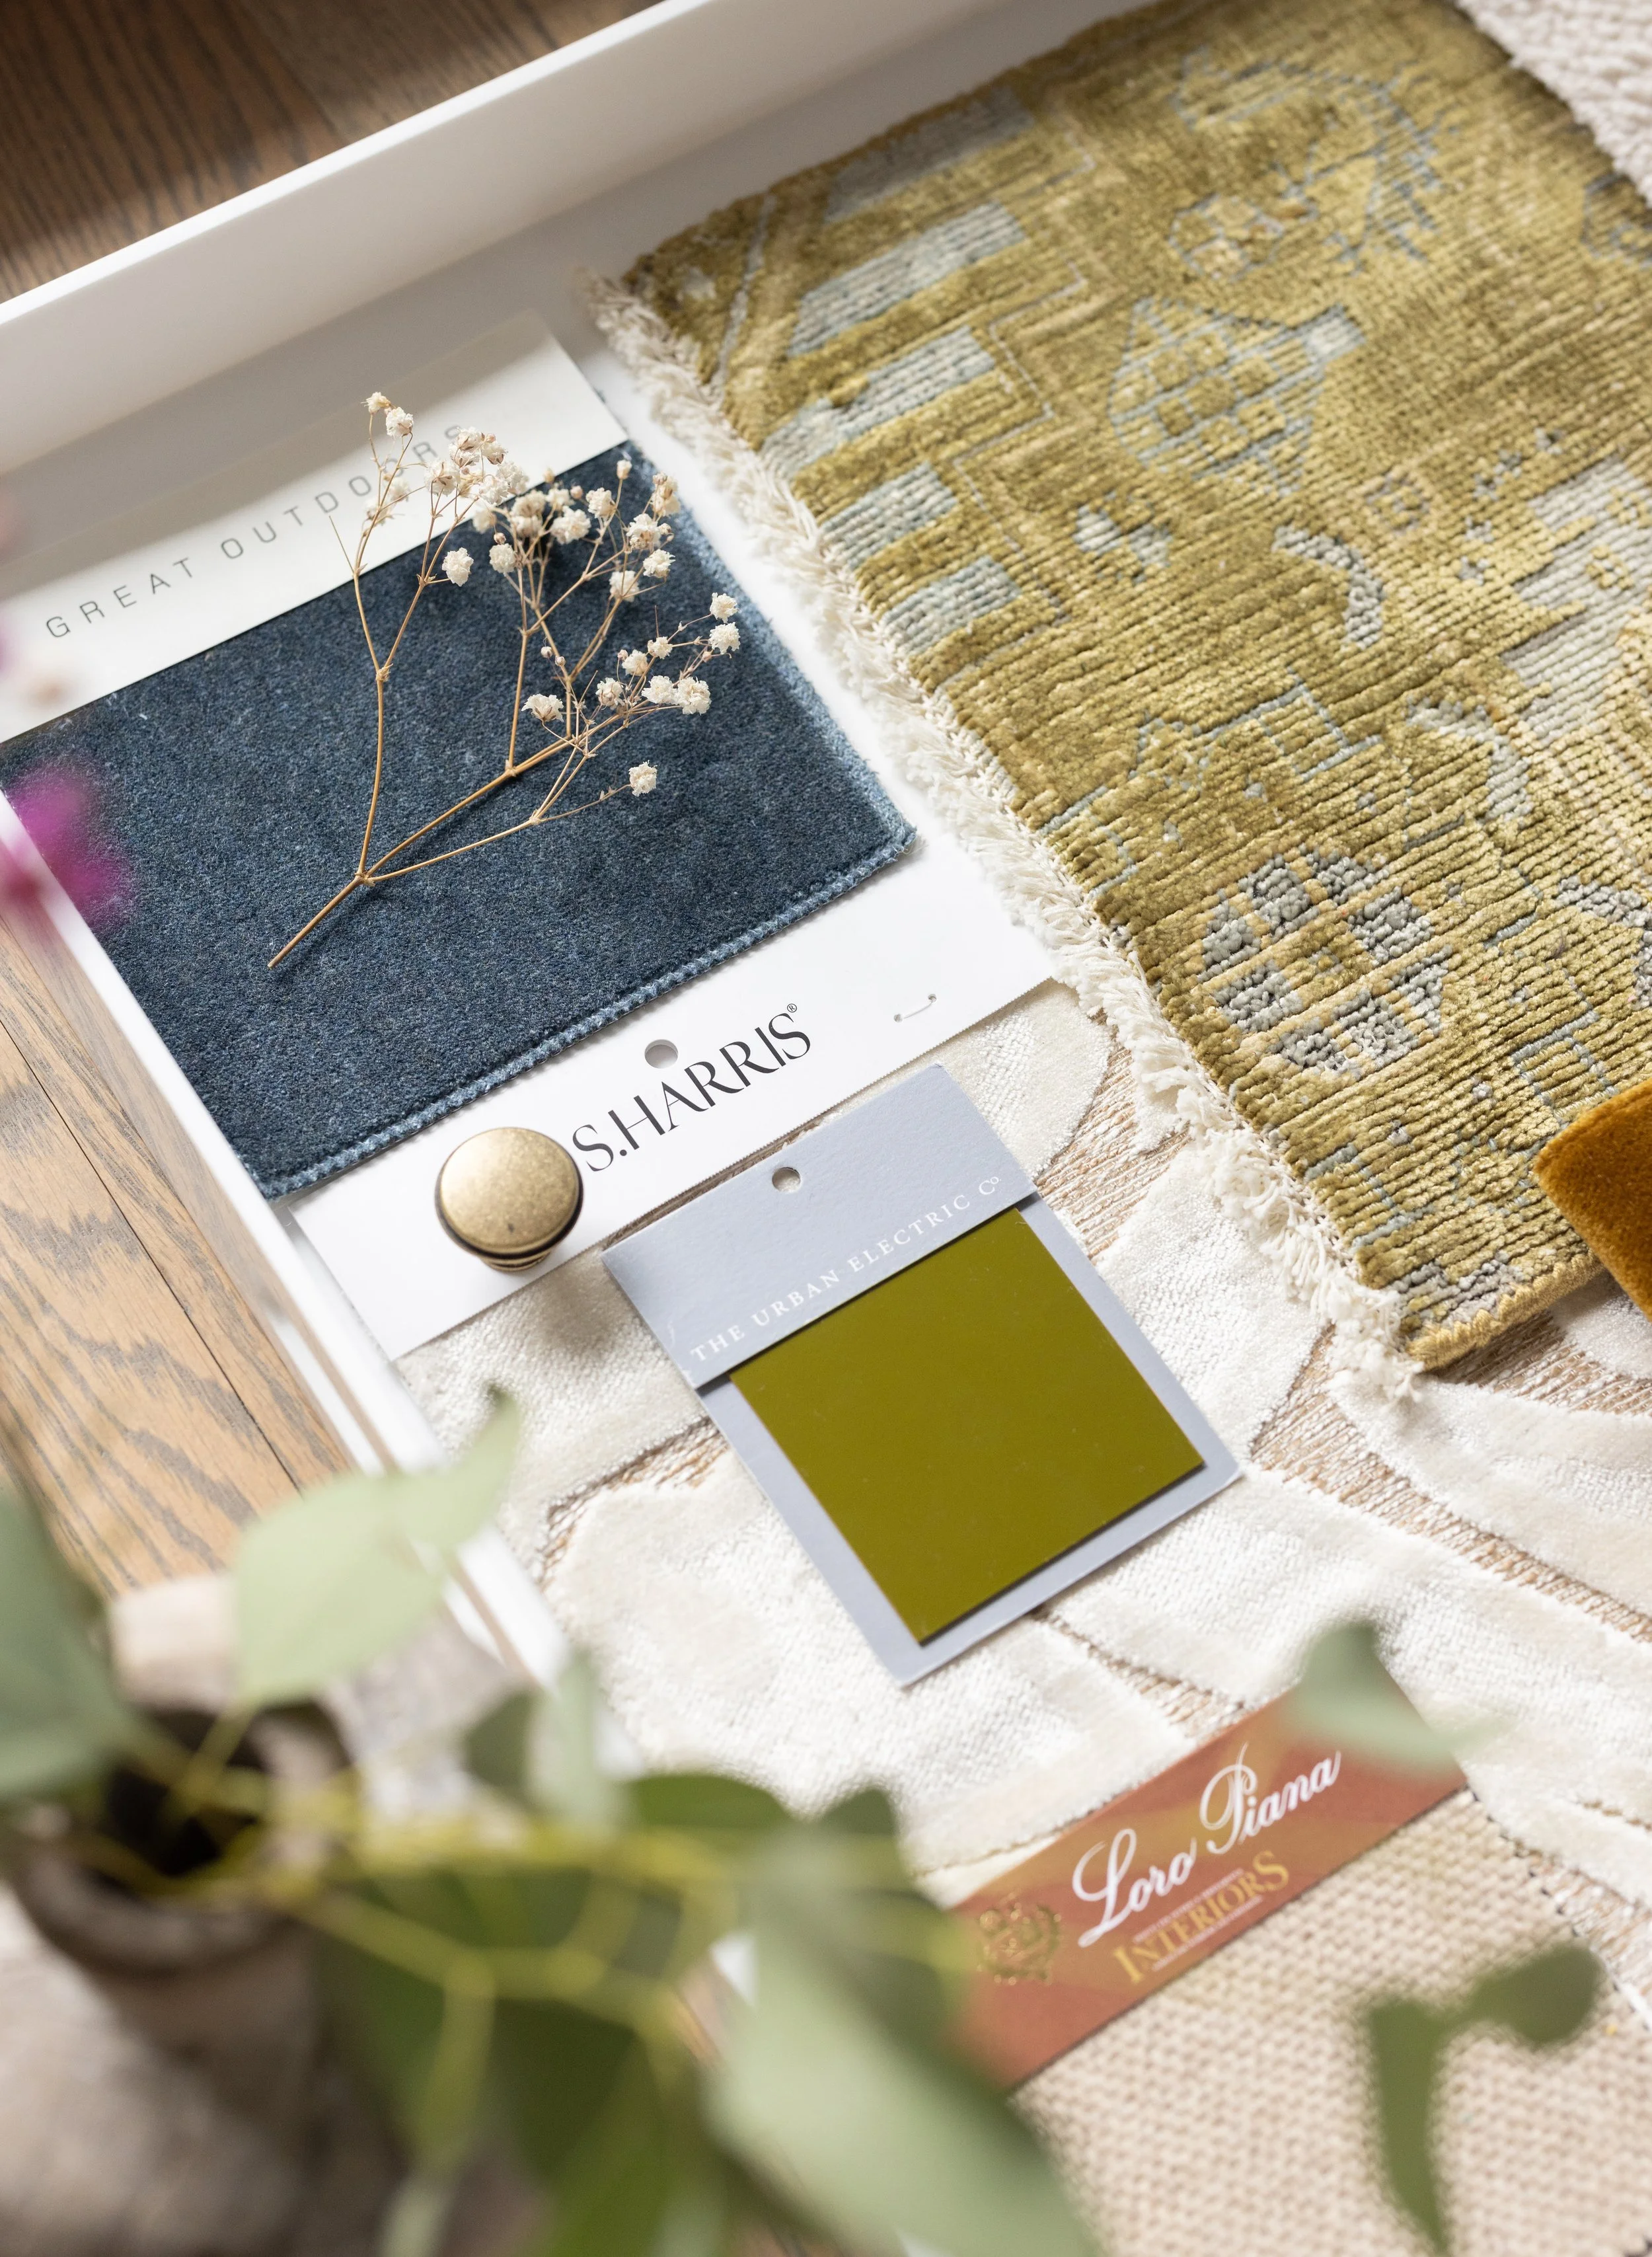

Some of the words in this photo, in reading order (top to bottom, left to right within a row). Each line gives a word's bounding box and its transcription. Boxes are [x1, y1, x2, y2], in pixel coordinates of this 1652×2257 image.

[46, 557, 193, 638] GREAT
[691, 1324, 745, 1361] THE
[750, 1270, 841, 1327] URBAN
[847, 1195, 970, 1273] ELECTRIC
[1072, 1828, 1197, 1948] Loro
[1199, 1741, 1341, 1855] Piana
[1113, 1850, 1289, 1983] INTERIORS
